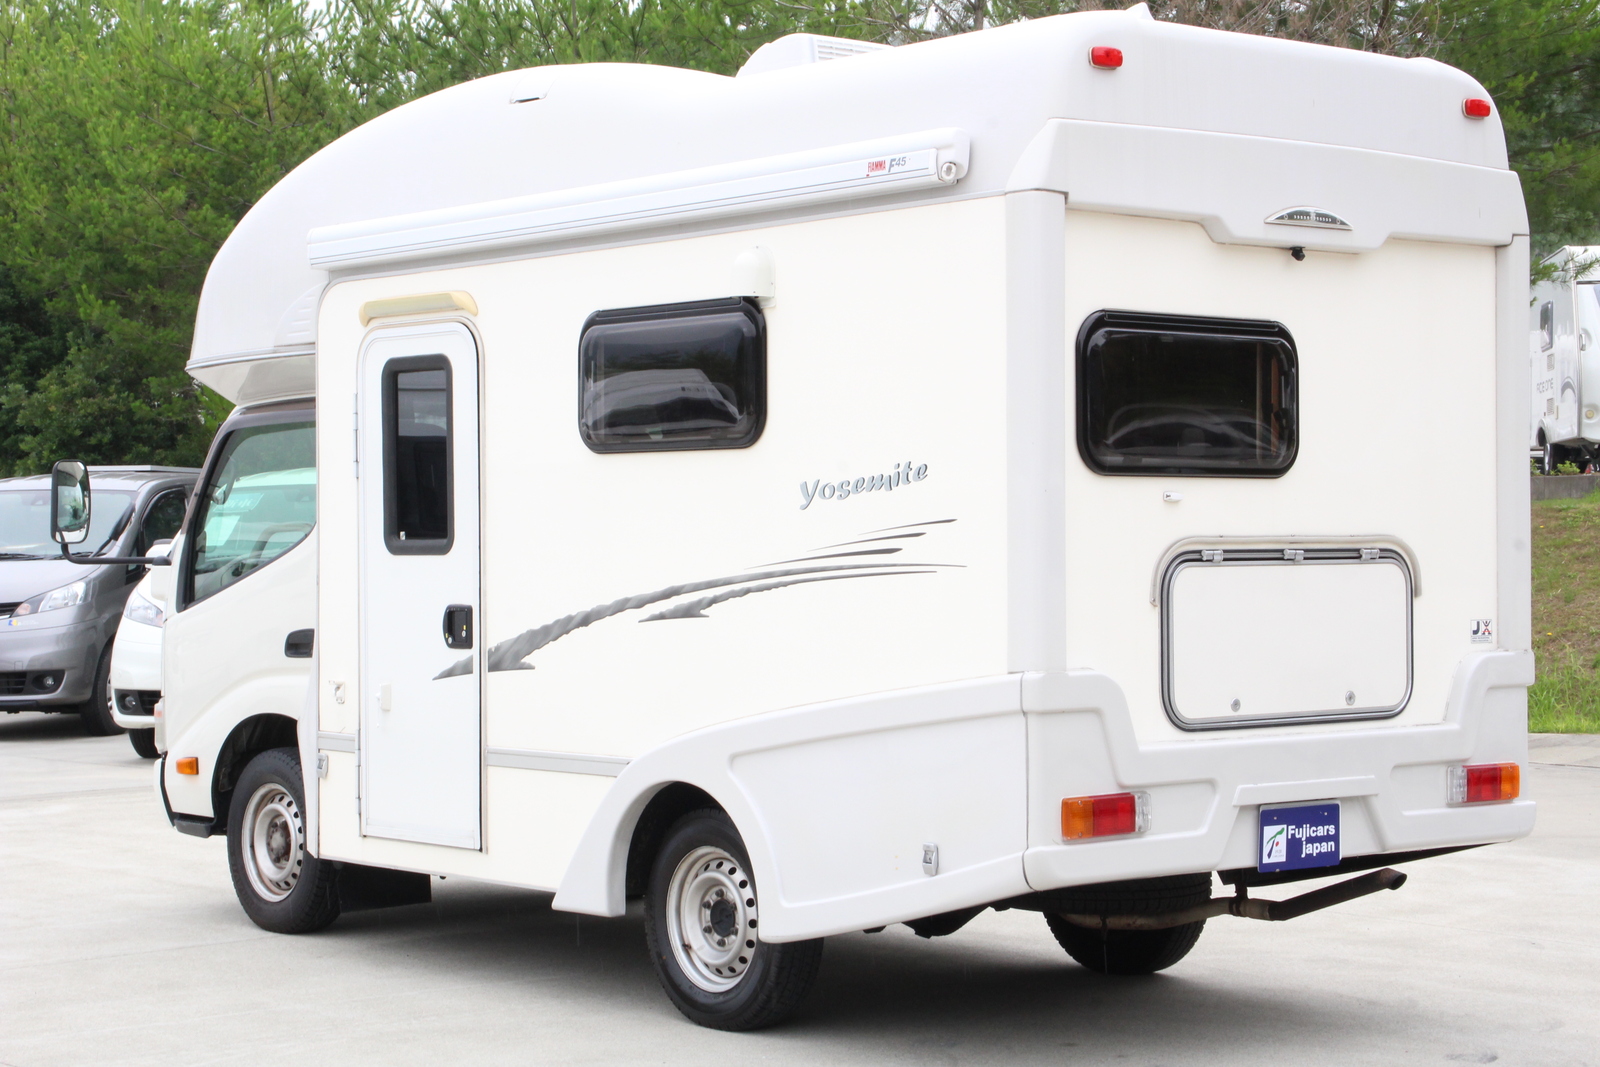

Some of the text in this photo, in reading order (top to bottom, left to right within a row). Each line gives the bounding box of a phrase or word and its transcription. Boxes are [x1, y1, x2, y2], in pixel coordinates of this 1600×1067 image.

[867, 156, 907, 173] FIAMMA F45
[1287, 824, 1336, 841] Fujicars
[1301, 841, 1335, 858] japan
